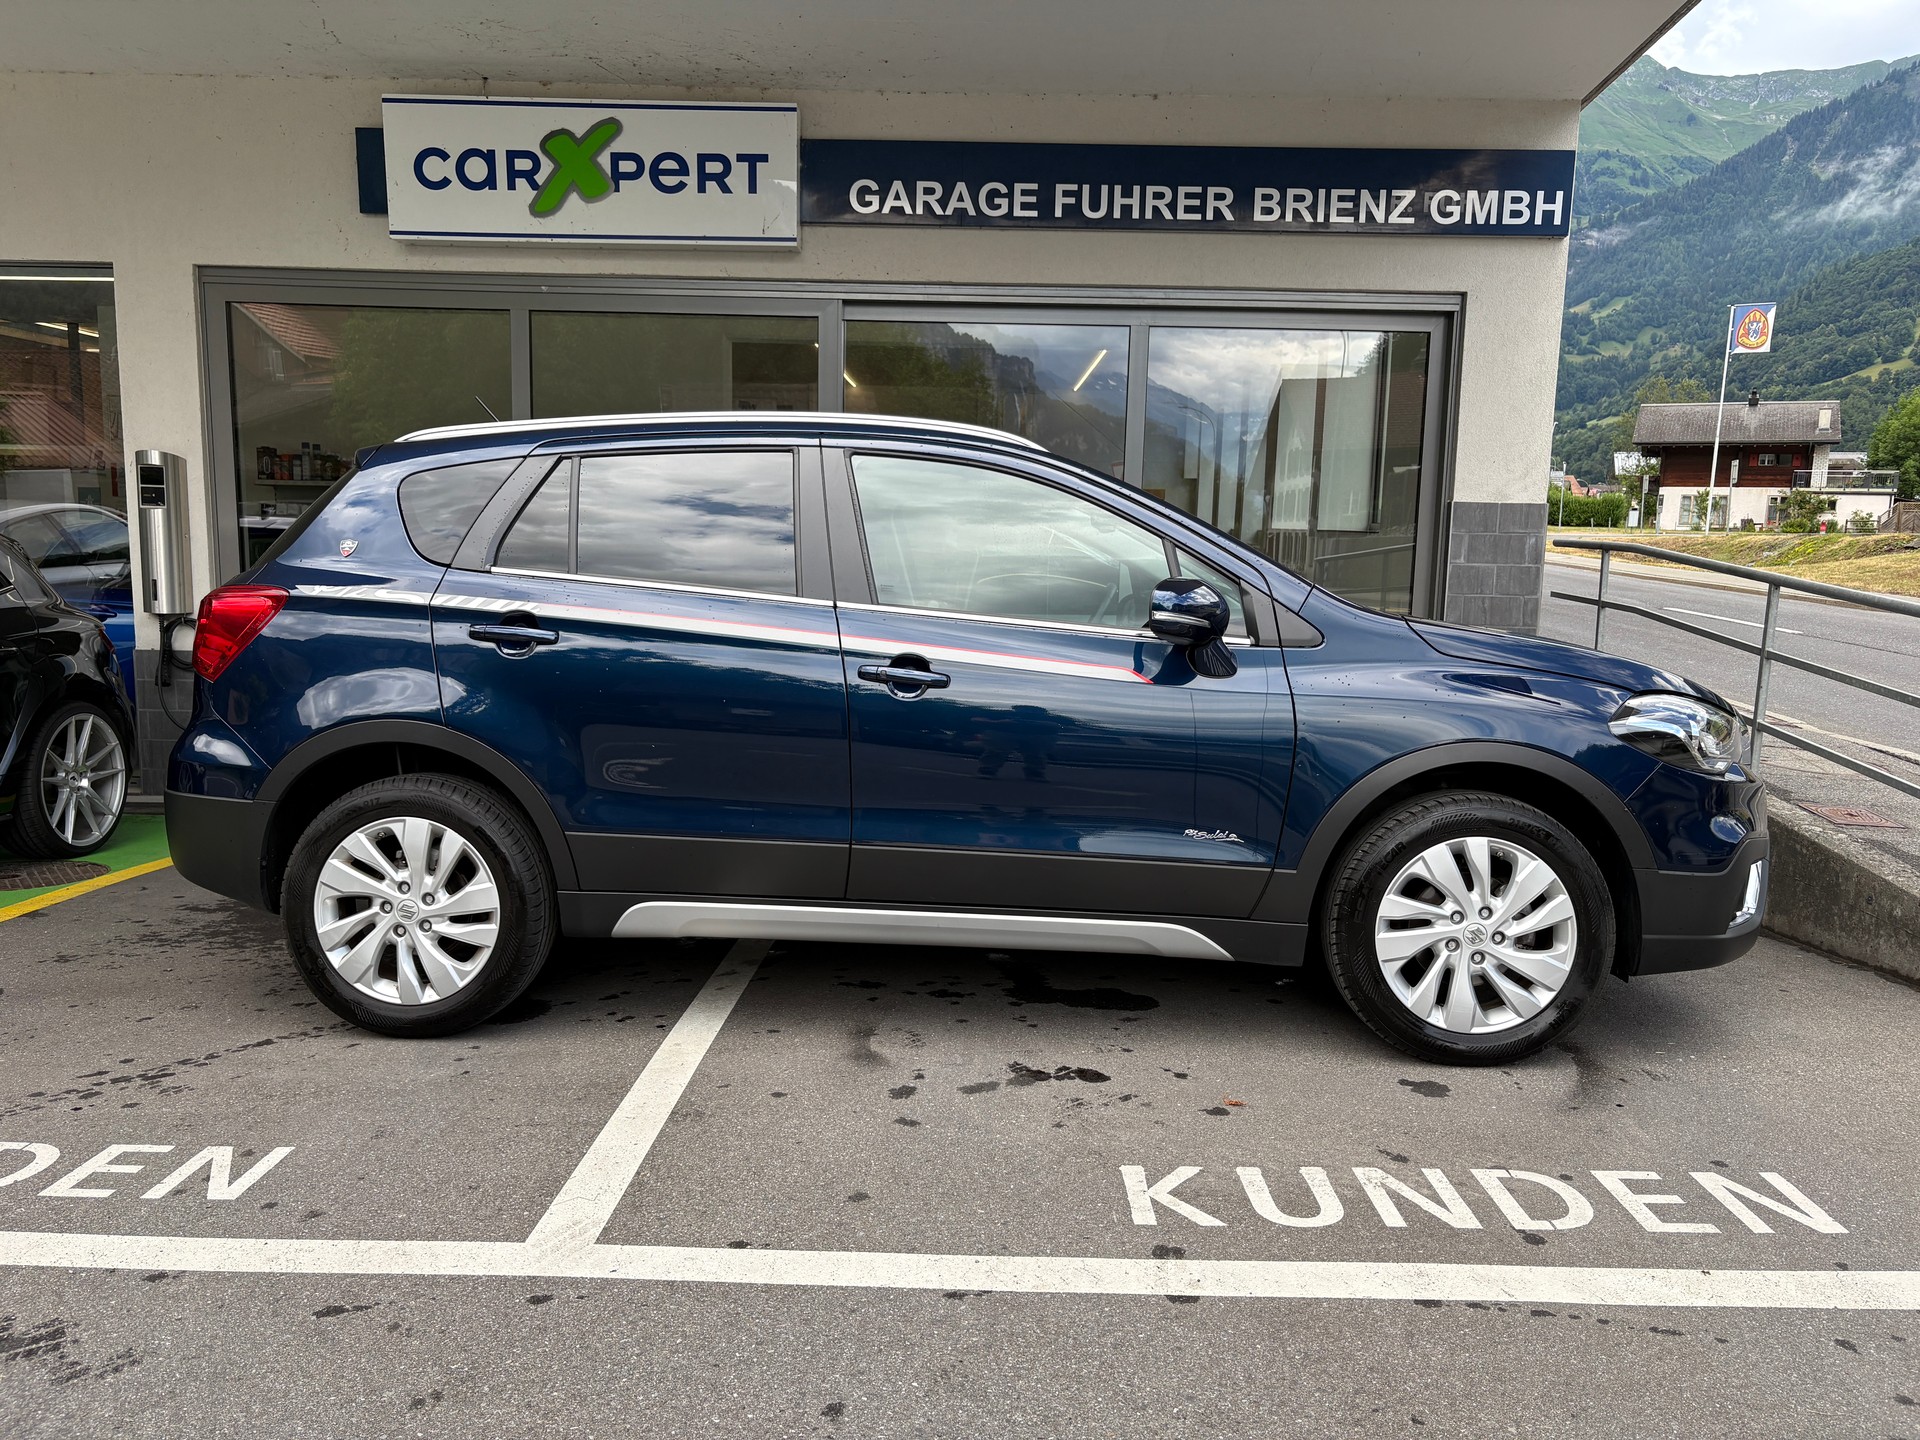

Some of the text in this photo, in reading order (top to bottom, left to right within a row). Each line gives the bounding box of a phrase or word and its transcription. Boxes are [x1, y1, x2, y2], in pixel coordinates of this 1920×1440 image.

[850, 179, 1038, 218] GARAGE
[1055, 184, 1235, 221] FUHRER
[1253, 187, 1417, 224] BRIENZ
[1430, 189, 1564, 226] GMBH
[1118, 1164, 1850, 1235] KUNDEN
